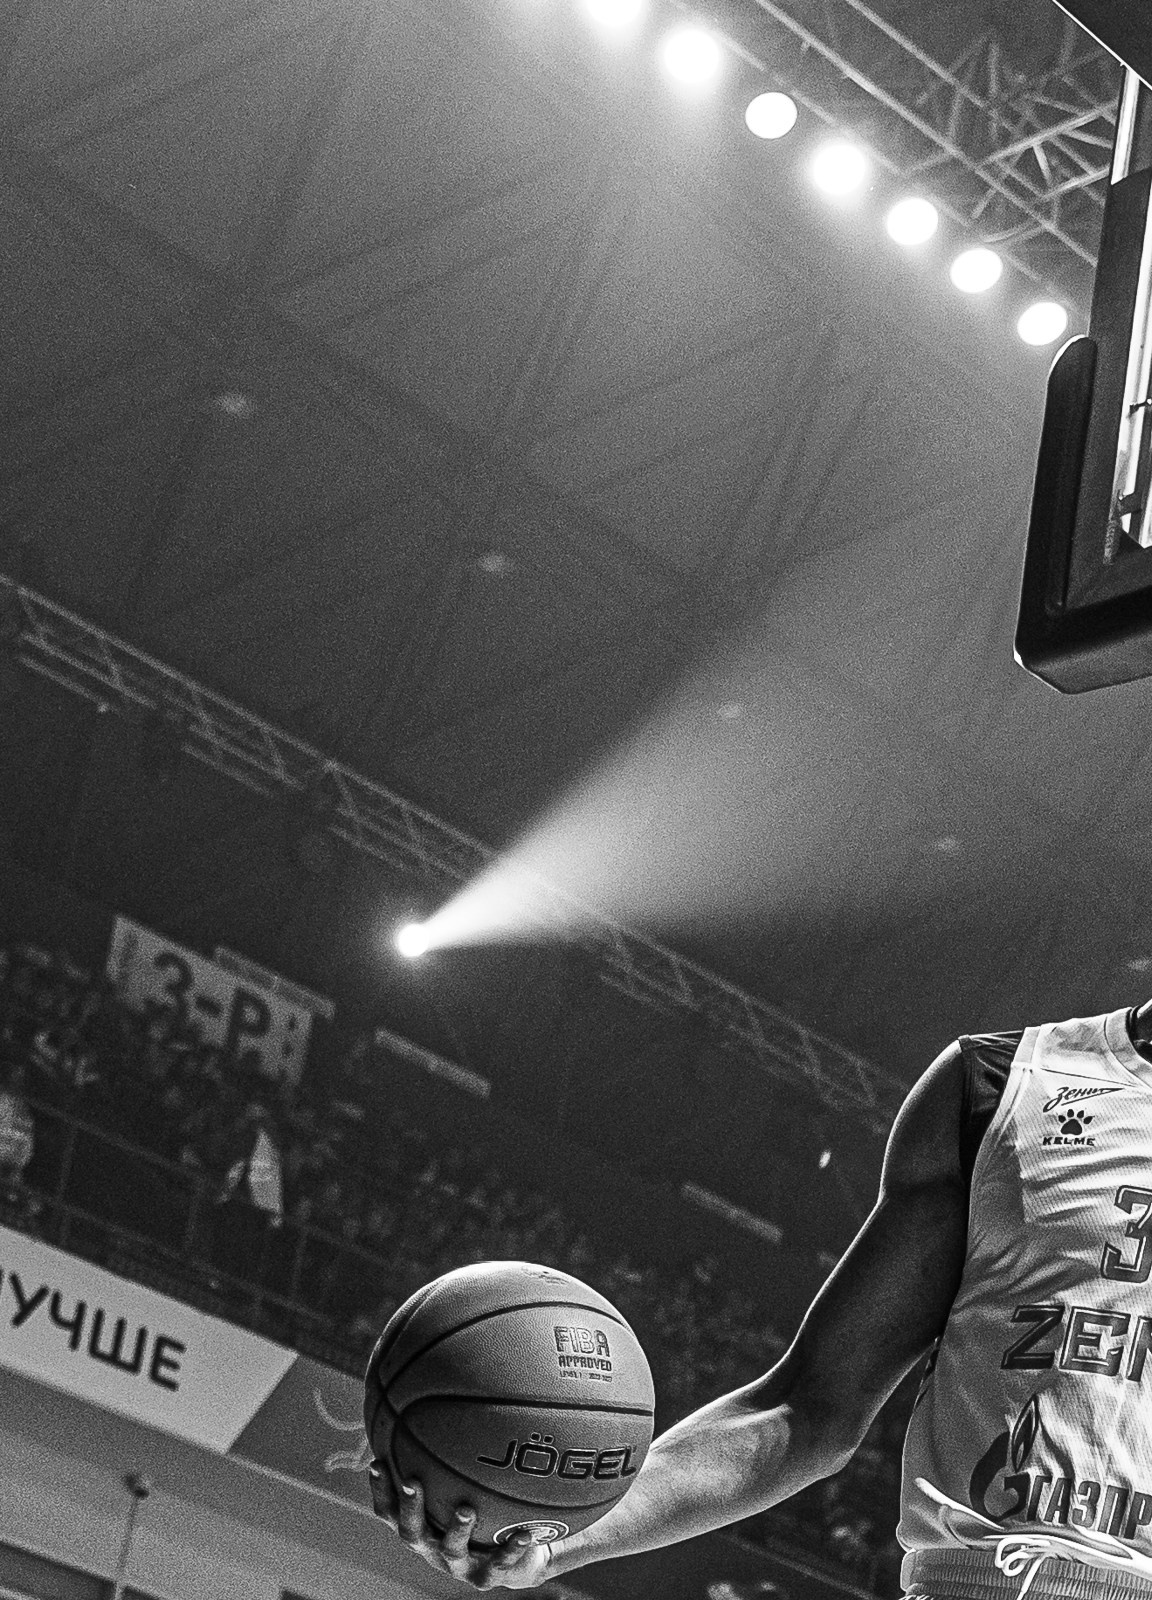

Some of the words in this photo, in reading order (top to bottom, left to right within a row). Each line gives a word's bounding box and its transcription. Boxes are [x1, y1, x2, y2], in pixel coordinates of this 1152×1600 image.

[1042, 1136, 1096, 1146] KELME
[0, 1266, 187, 1392] УЧШЕ
[553, 1325, 611, 1358] FIBA
[558, 1354, 613, 1372] APPROVED
[476, 1431, 638, 1480] JÖGEL
